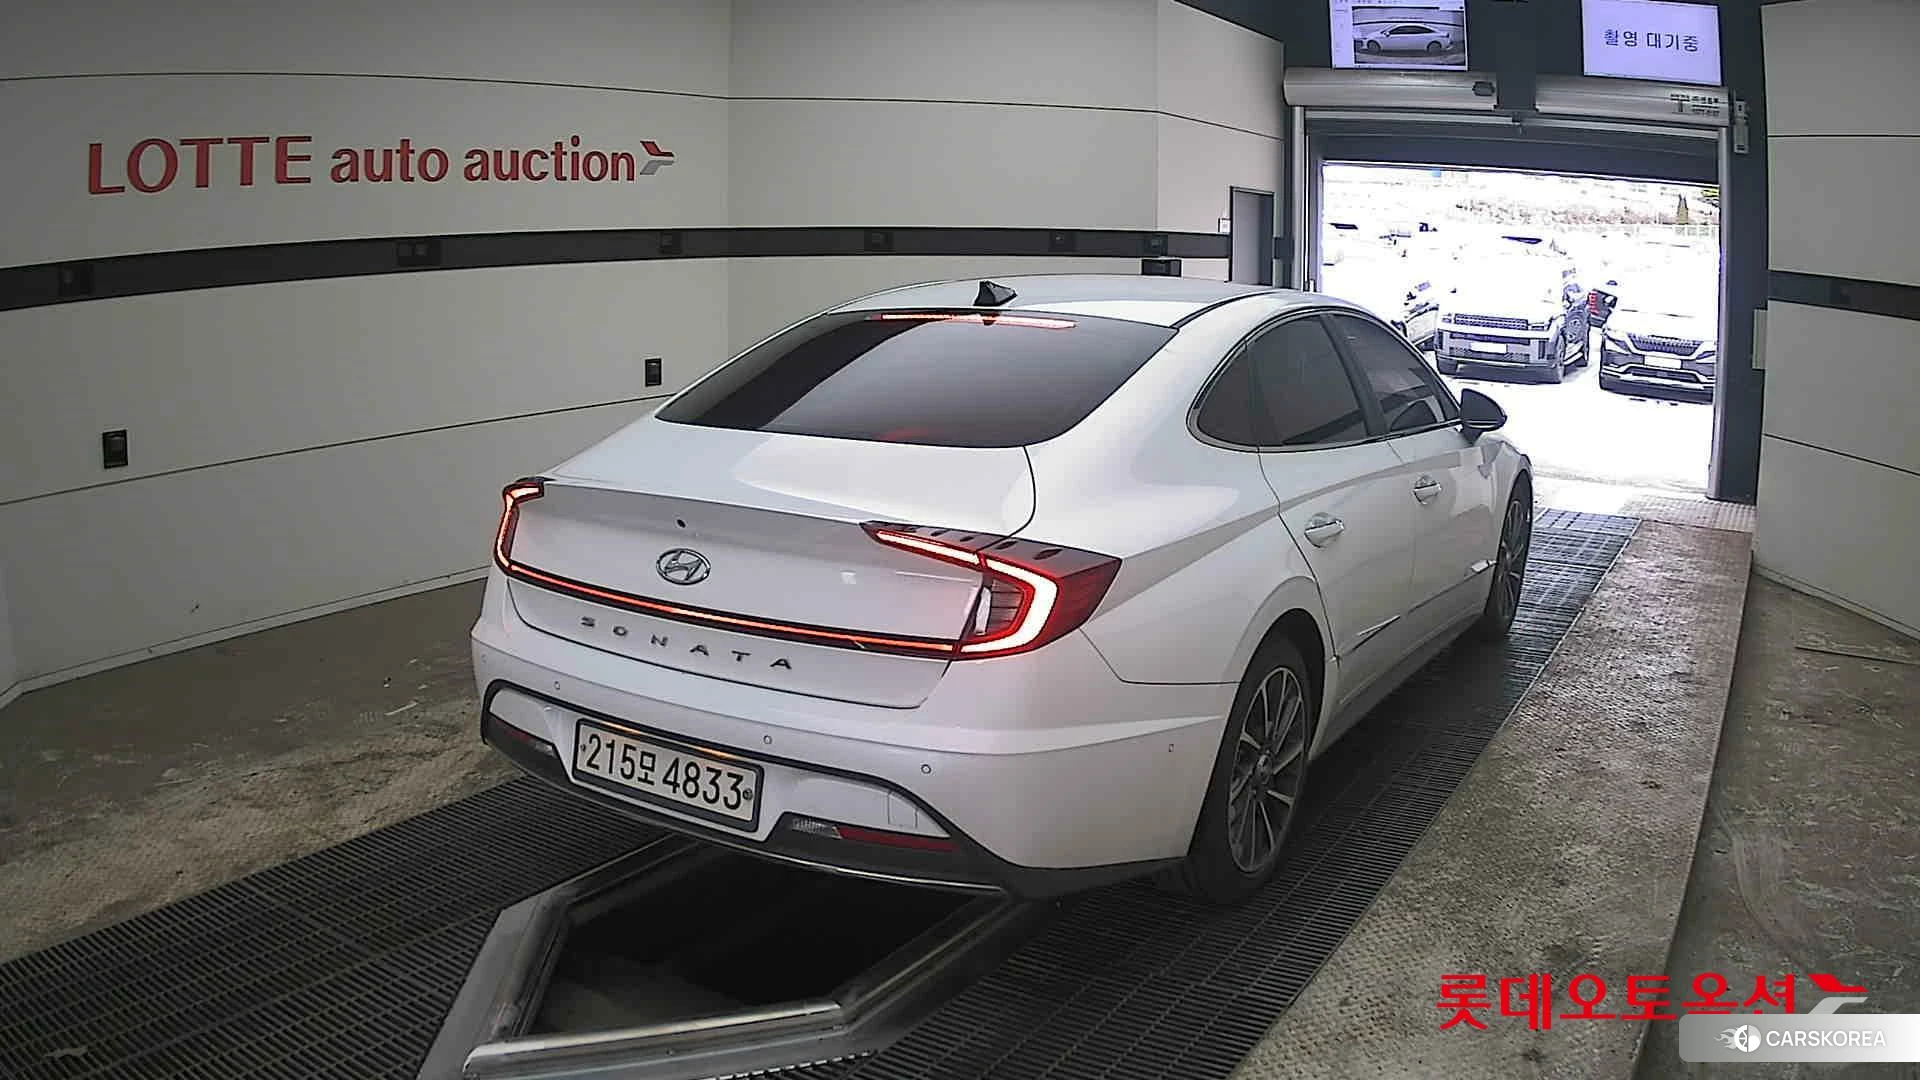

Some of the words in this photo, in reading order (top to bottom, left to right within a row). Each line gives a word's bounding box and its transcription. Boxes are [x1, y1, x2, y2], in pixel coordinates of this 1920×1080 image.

[1646, 32, 1698, 52] 대기중
[87, 135, 312, 195] LOTTE
[329, 138, 449, 184] auto
[463, 134, 636, 183] auction
[580, 615, 793, 670] SONATA
[586, 733, 656, 787] 215모
[662, 757, 744, 811] 4833
